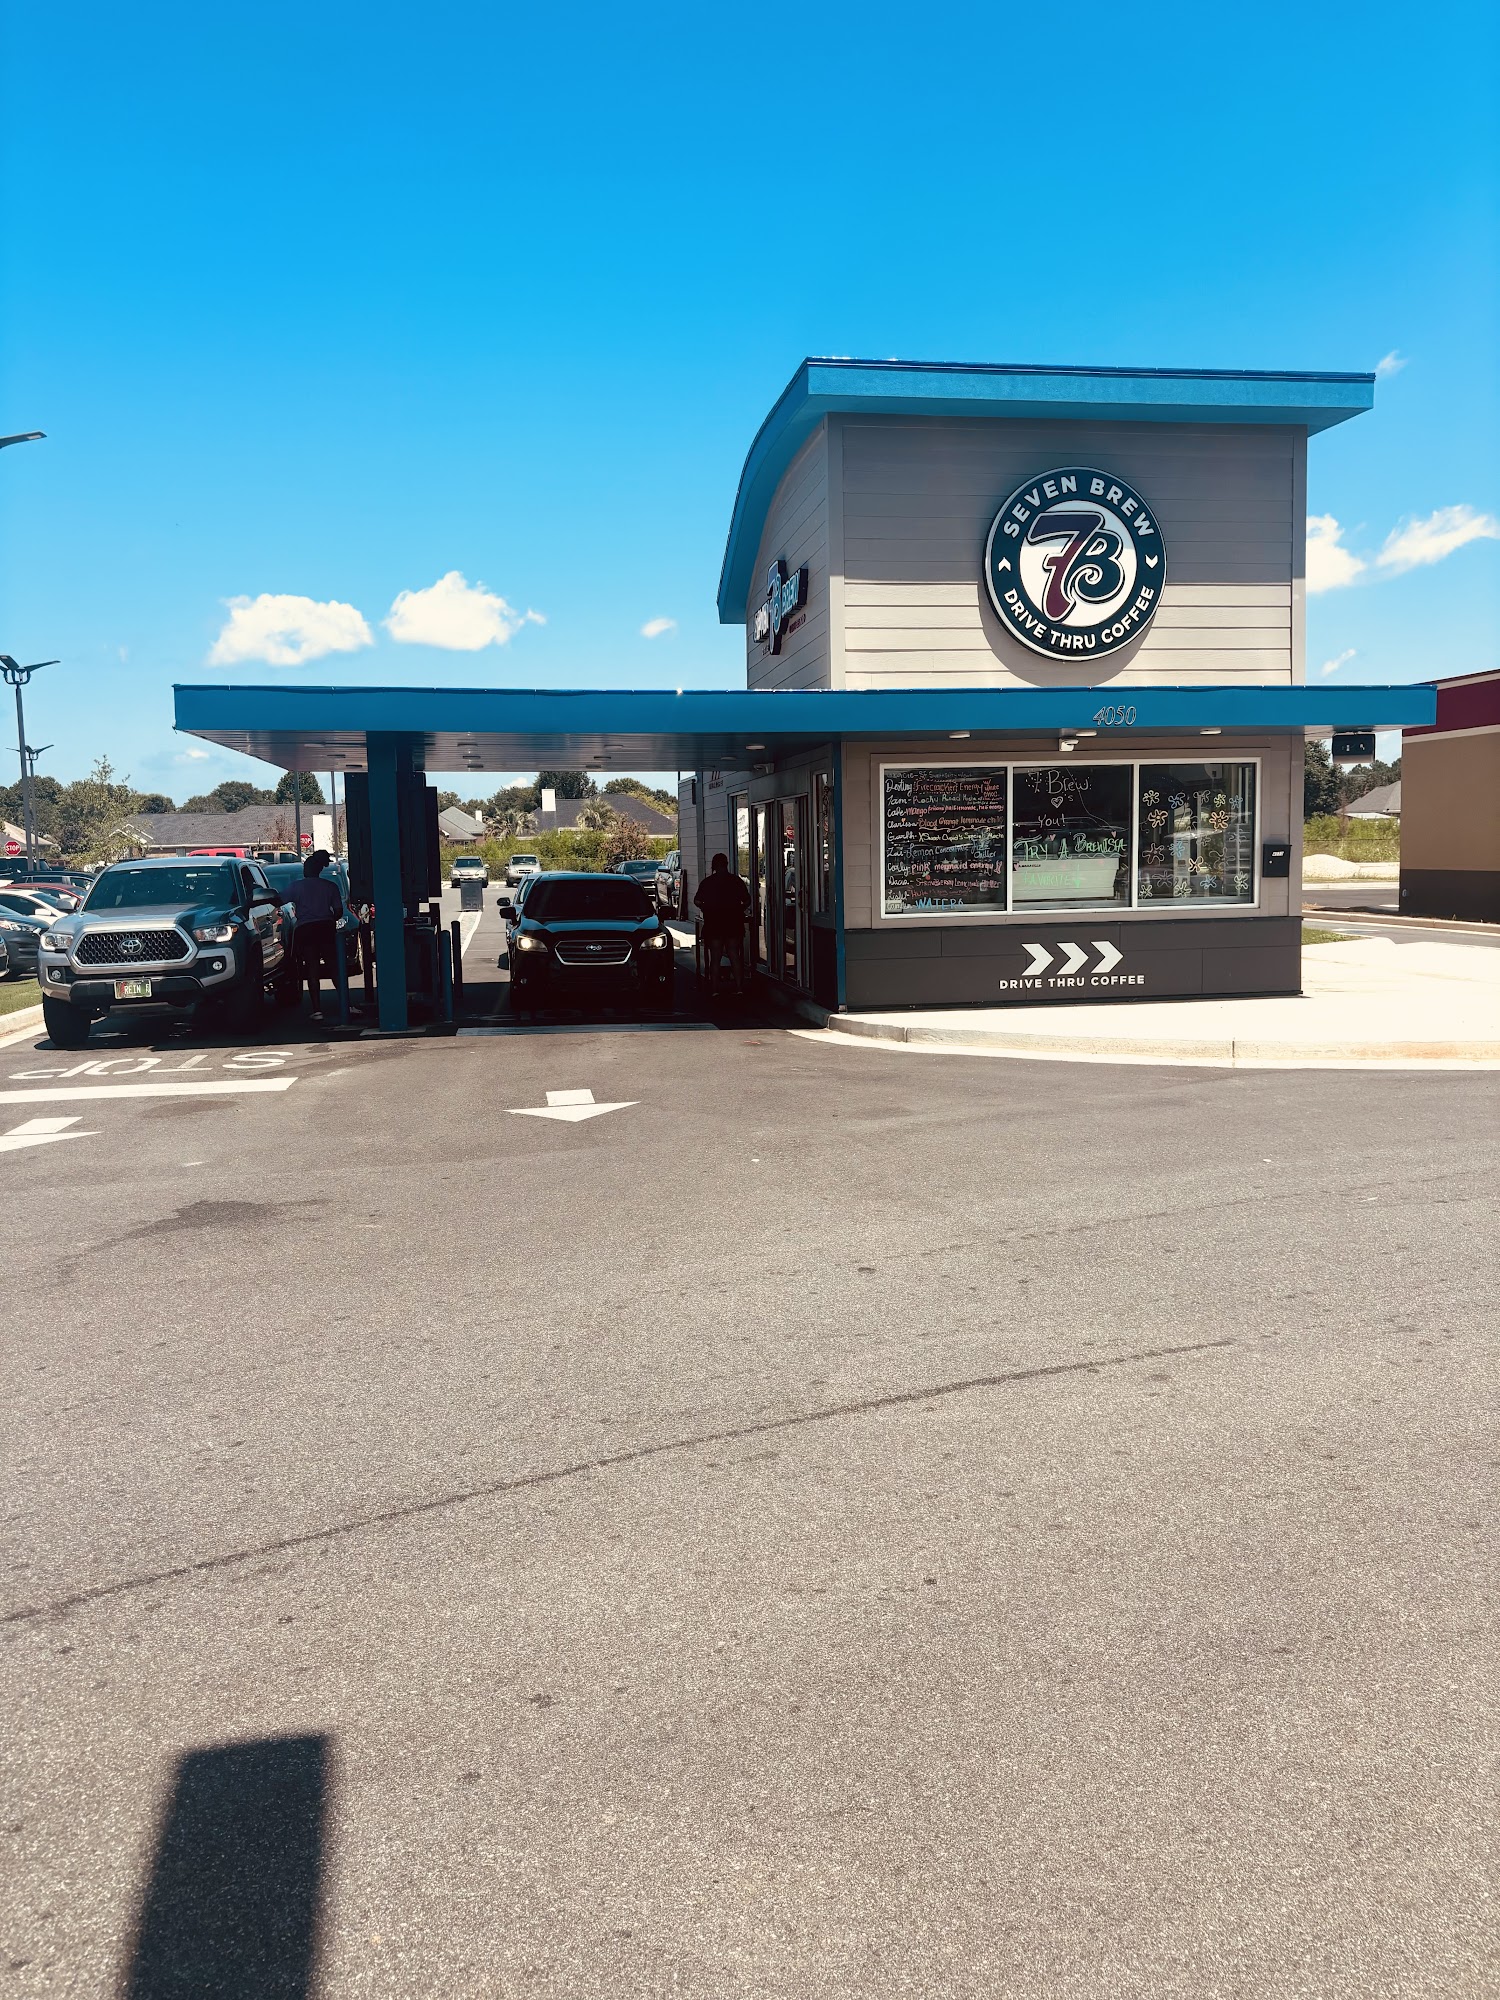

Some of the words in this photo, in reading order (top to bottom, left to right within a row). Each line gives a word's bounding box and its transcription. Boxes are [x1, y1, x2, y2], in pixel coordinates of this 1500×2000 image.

[1003, 475, 1077, 538] SEVEN
[1090, 477, 1155, 537] BREW
[1004, 588, 1047, 639] DRIVE
[1050, 630, 1096, 649] THRU
[1101, 586, 1155, 644] COFFEE
[1092, 705, 1136, 725] 4050
[1048, 769, 1089, 794] Brew
[1038, 813, 1066, 828] You!
[1058, 838, 1072, 860] A
[999, 979, 1043, 990] DRIVE
[1048, 977, 1085, 987] THRU
[1091, 975, 1145, 986] COFFEE
[8, 1051, 294, 1080] STOP
